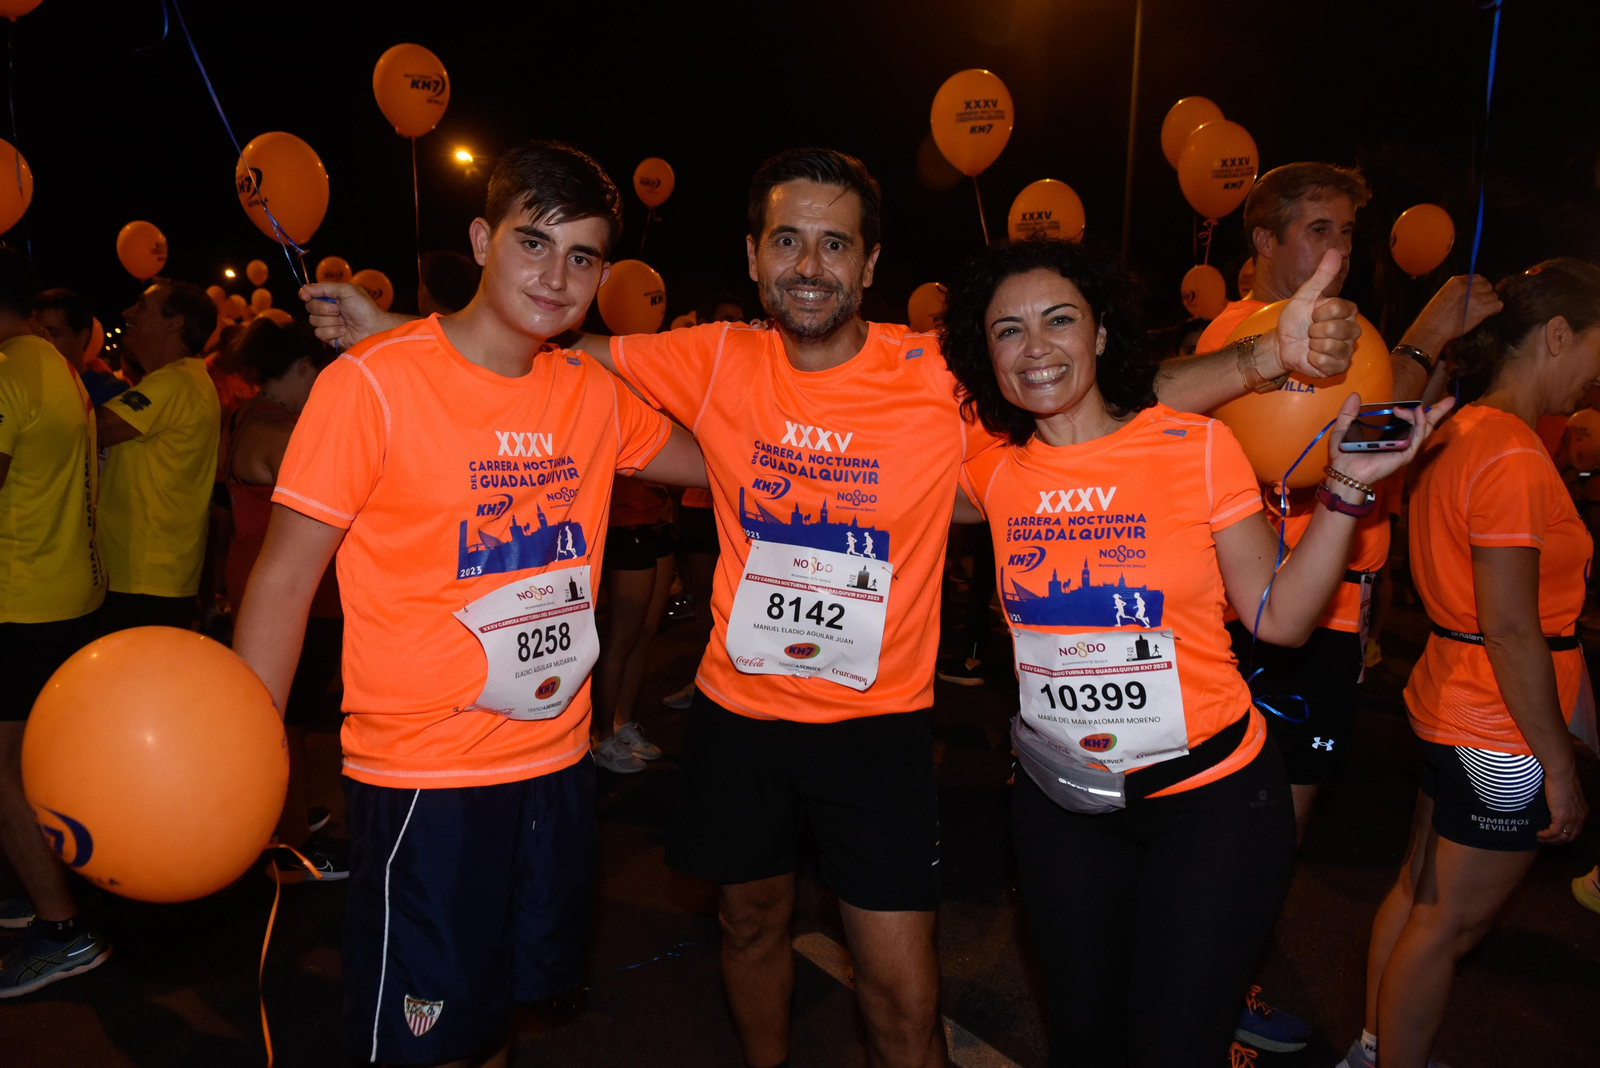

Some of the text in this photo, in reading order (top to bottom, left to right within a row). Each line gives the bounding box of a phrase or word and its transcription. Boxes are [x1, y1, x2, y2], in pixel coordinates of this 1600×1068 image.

[965, 99, 998, 110] XXXV
[1221, 157, 1250, 167] XXXV
[1021, 211, 1052, 221] XXXV
[495, 430, 553, 457] XXXV
[780, 420, 853, 453] XXXV
[751, 450, 759, 465] DEL
[754, 440, 880, 469] CARRERA NOCTURNA
[469, 455, 575, 472] CARRERA NOCTURNA
[759, 454, 879, 485] GUADALQUIVIR
[480, 467, 580, 489] GUADALQUIVIR
[1035, 486, 1117, 514] XXXV
[1007, 513, 1147, 527] CARRERA NOCTURNA
[1012, 526, 1147, 542] GUADALQUIVIR
[460, 566, 483, 578] 2023
[761, 576, 781, 585] CARRERA
[780, 580, 807, 589] NOCTURNA
[766, 592, 846, 631] 8142
[498, 618, 520, 628] CARRERA
[520, 614, 540, 623] NOCTURNA
[753, 623, 854, 645] MANUEL ELADIO AGUILAR JUAN
[517, 622, 571, 663] 8258
[515, 656, 577, 679] ELADIO AGUILAR MUDARRA
[831, 667, 868, 684] Cruzcampo
[1052, 669, 1085, 677] NOCTURNA
[1095, 666, 1140, 674] GUADALQUIVIR
[1040, 680, 1147, 713] 10399
[1058, 716, 1070, 724] DEL
[1070, 717, 1087, 726] MAR
[1088, 716, 1125, 725] PALOMAR
[1126, 716, 1161, 725] MORENO
[1471, 814, 1530, 825] BOMBEROS
[1479, 823, 1517, 832] SEVILLA
